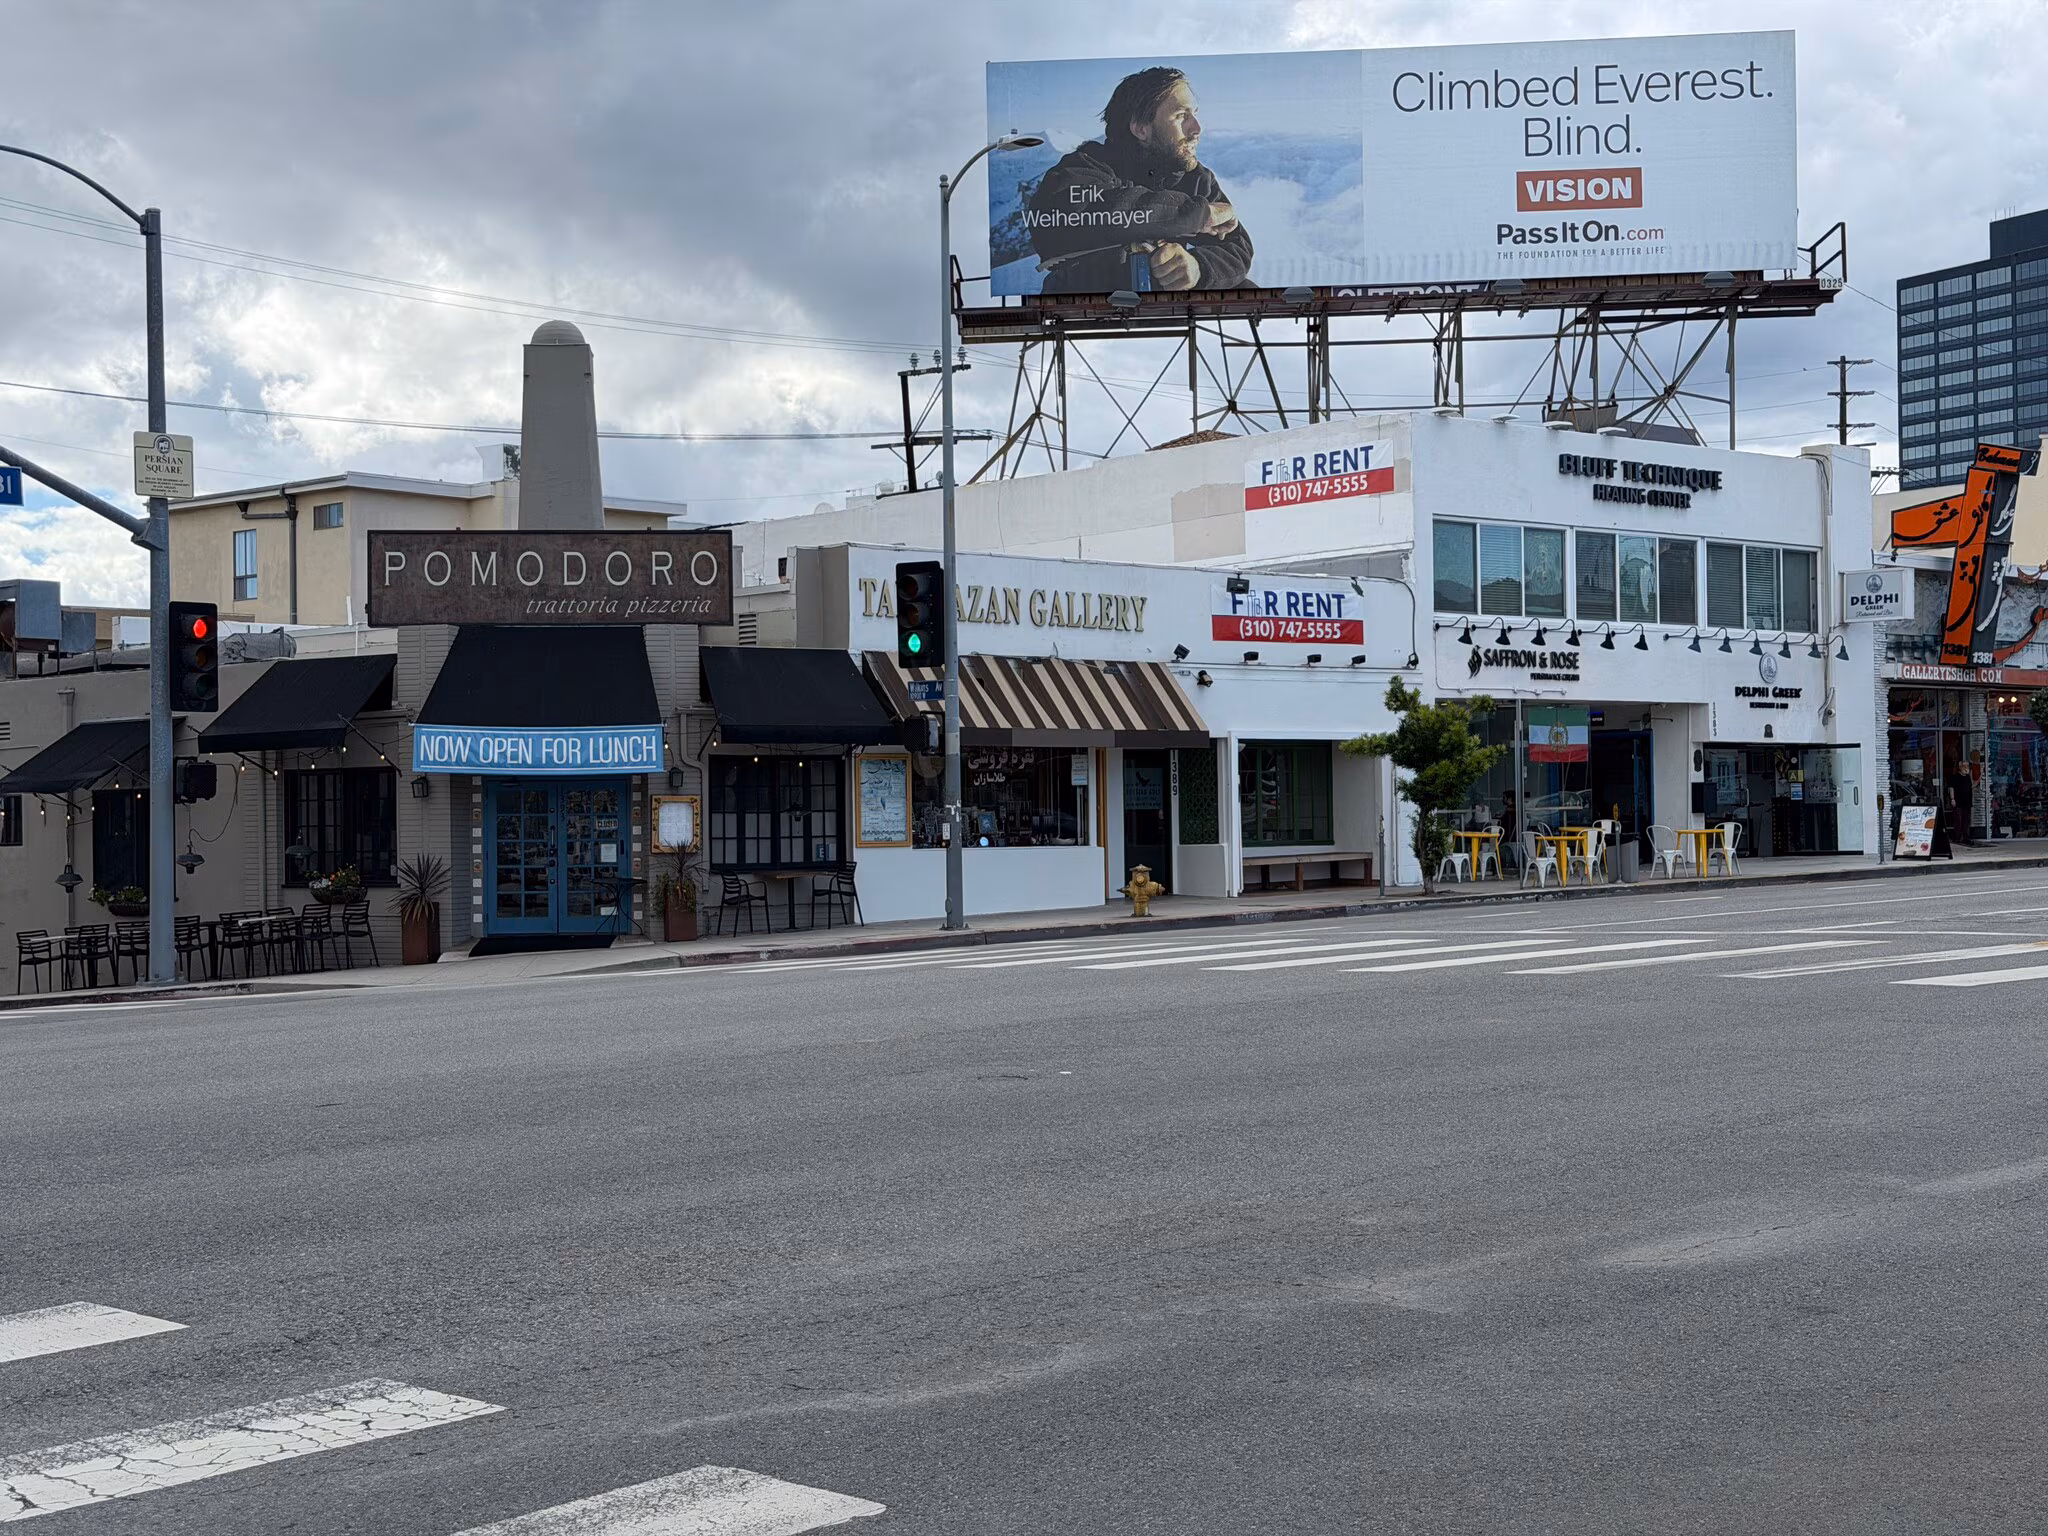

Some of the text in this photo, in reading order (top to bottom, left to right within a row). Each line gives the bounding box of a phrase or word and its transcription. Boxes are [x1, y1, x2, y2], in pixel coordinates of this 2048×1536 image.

[1392, 60, 1774, 113] Climbed Everest.
[1524, 114, 1643, 158] Blind.
[1069, 185, 1105, 204] Erik
[1525, 176, 1632, 203] VISION
[1021, 207, 1154, 229] Weihenmayer
[1496, 220, 1665, 245] PassItOn.com
[1497, 246, 1666, 260] THE FOUNDATION FOR A BETTER LIFE
[1820, 278, 1843, 289] 0325
[144, 454, 184, 465] PERSIAN
[146, 464, 183, 475] SQUARE
[1314, 444, 1374, 477] RENT
[1558, 453, 1723, 492] BLUFF TECHNIQUE
[1267, 473, 1369, 505] (310) 747-5555
[1593, 483, 1692, 509] HEALING CENTER
[384, 550, 719, 588] POMODORO
[526, 595, 712, 618] trattoria pizzeria
[1030, 588, 1148, 632] GALLERY
[1286, 590, 1346, 619] RENT
[1850, 593, 1899, 606] DELPHI
[1239, 618, 1341, 640] (310) 747-5555
[1483, 648, 1580, 670] SAFFRON & ROSE
[1943, 643, 1969, 657] 1381
[1972, 651, 1993, 664] 1381
[935, 682, 942, 692] Av
[1735, 686, 1803, 698] DELPHI GREEK
[420, 731, 657, 765] NOW OPEN FOR LUNCH
[1011, 748, 1035, 770] نقره
[1789, 772, 1797, 781] A
